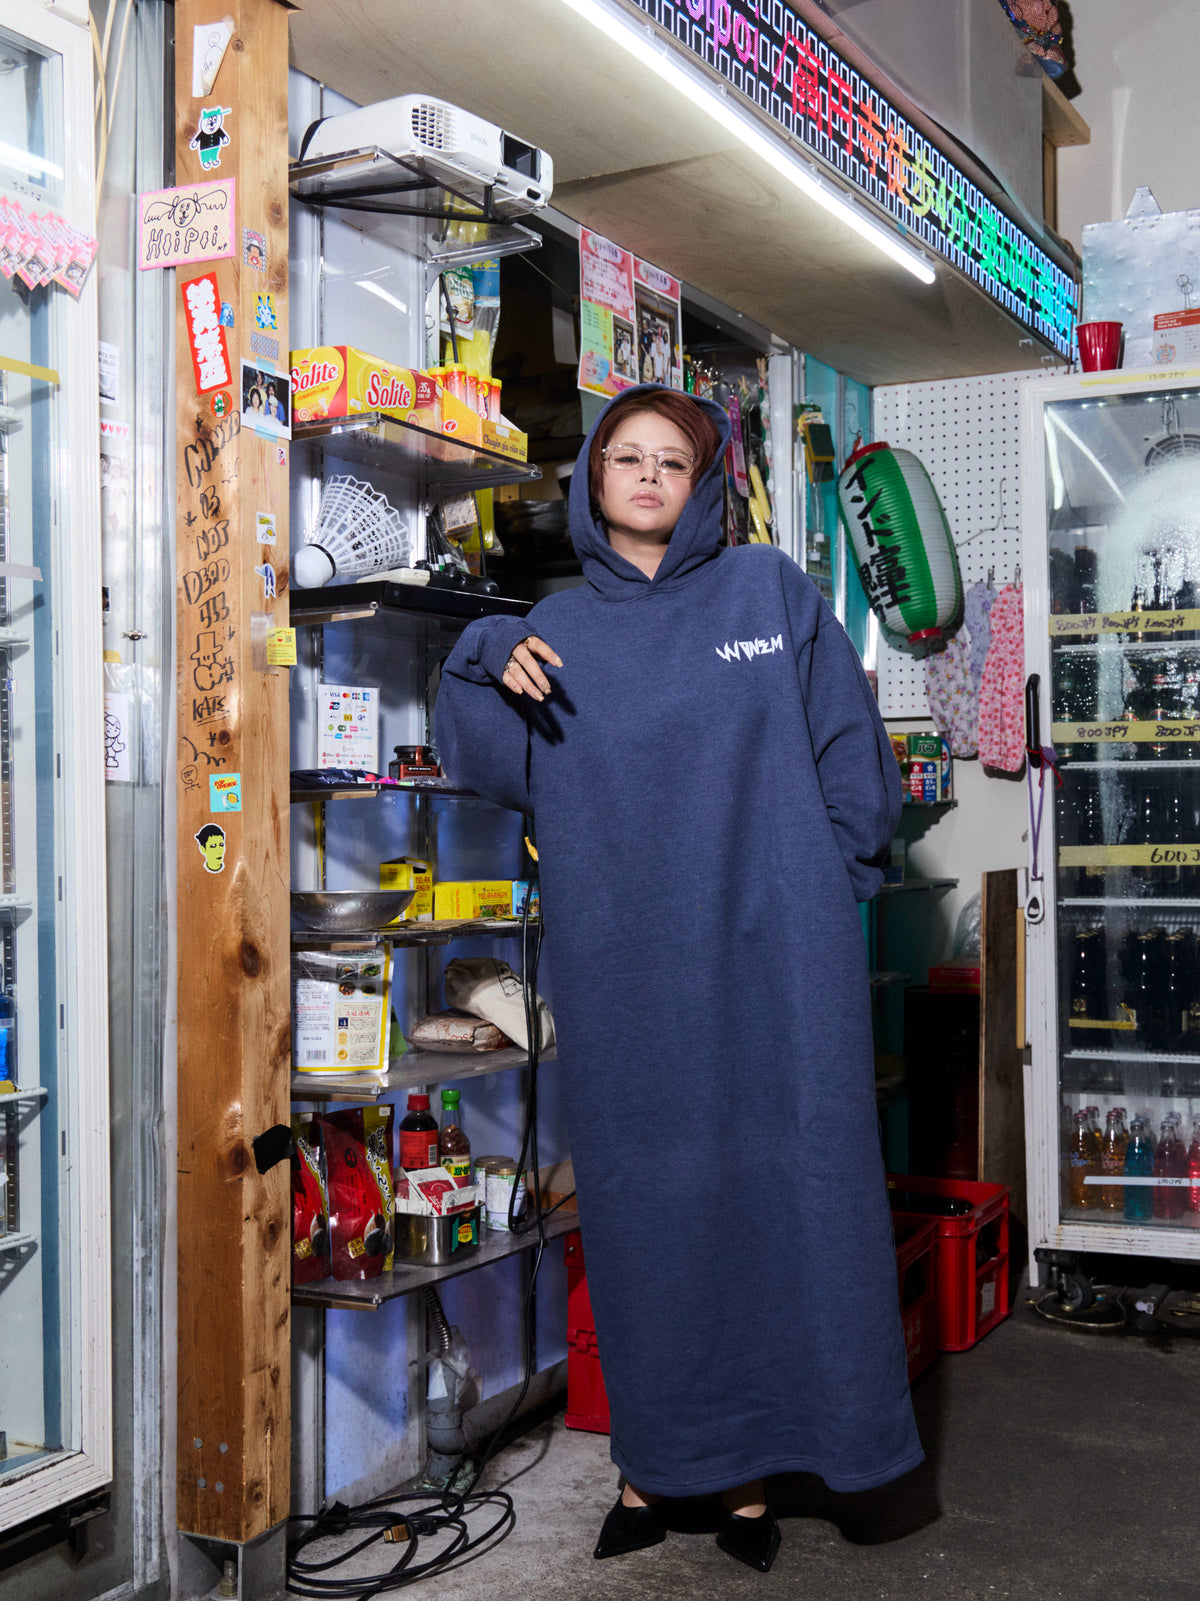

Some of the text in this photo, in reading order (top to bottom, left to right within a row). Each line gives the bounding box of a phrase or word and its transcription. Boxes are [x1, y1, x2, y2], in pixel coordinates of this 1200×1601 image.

[291, 361, 339, 395] Solite
[366, 371, 412, 408] Solite
[196, 519, 229, 561] NOT
[183, 558, 230, 605] DEAD
